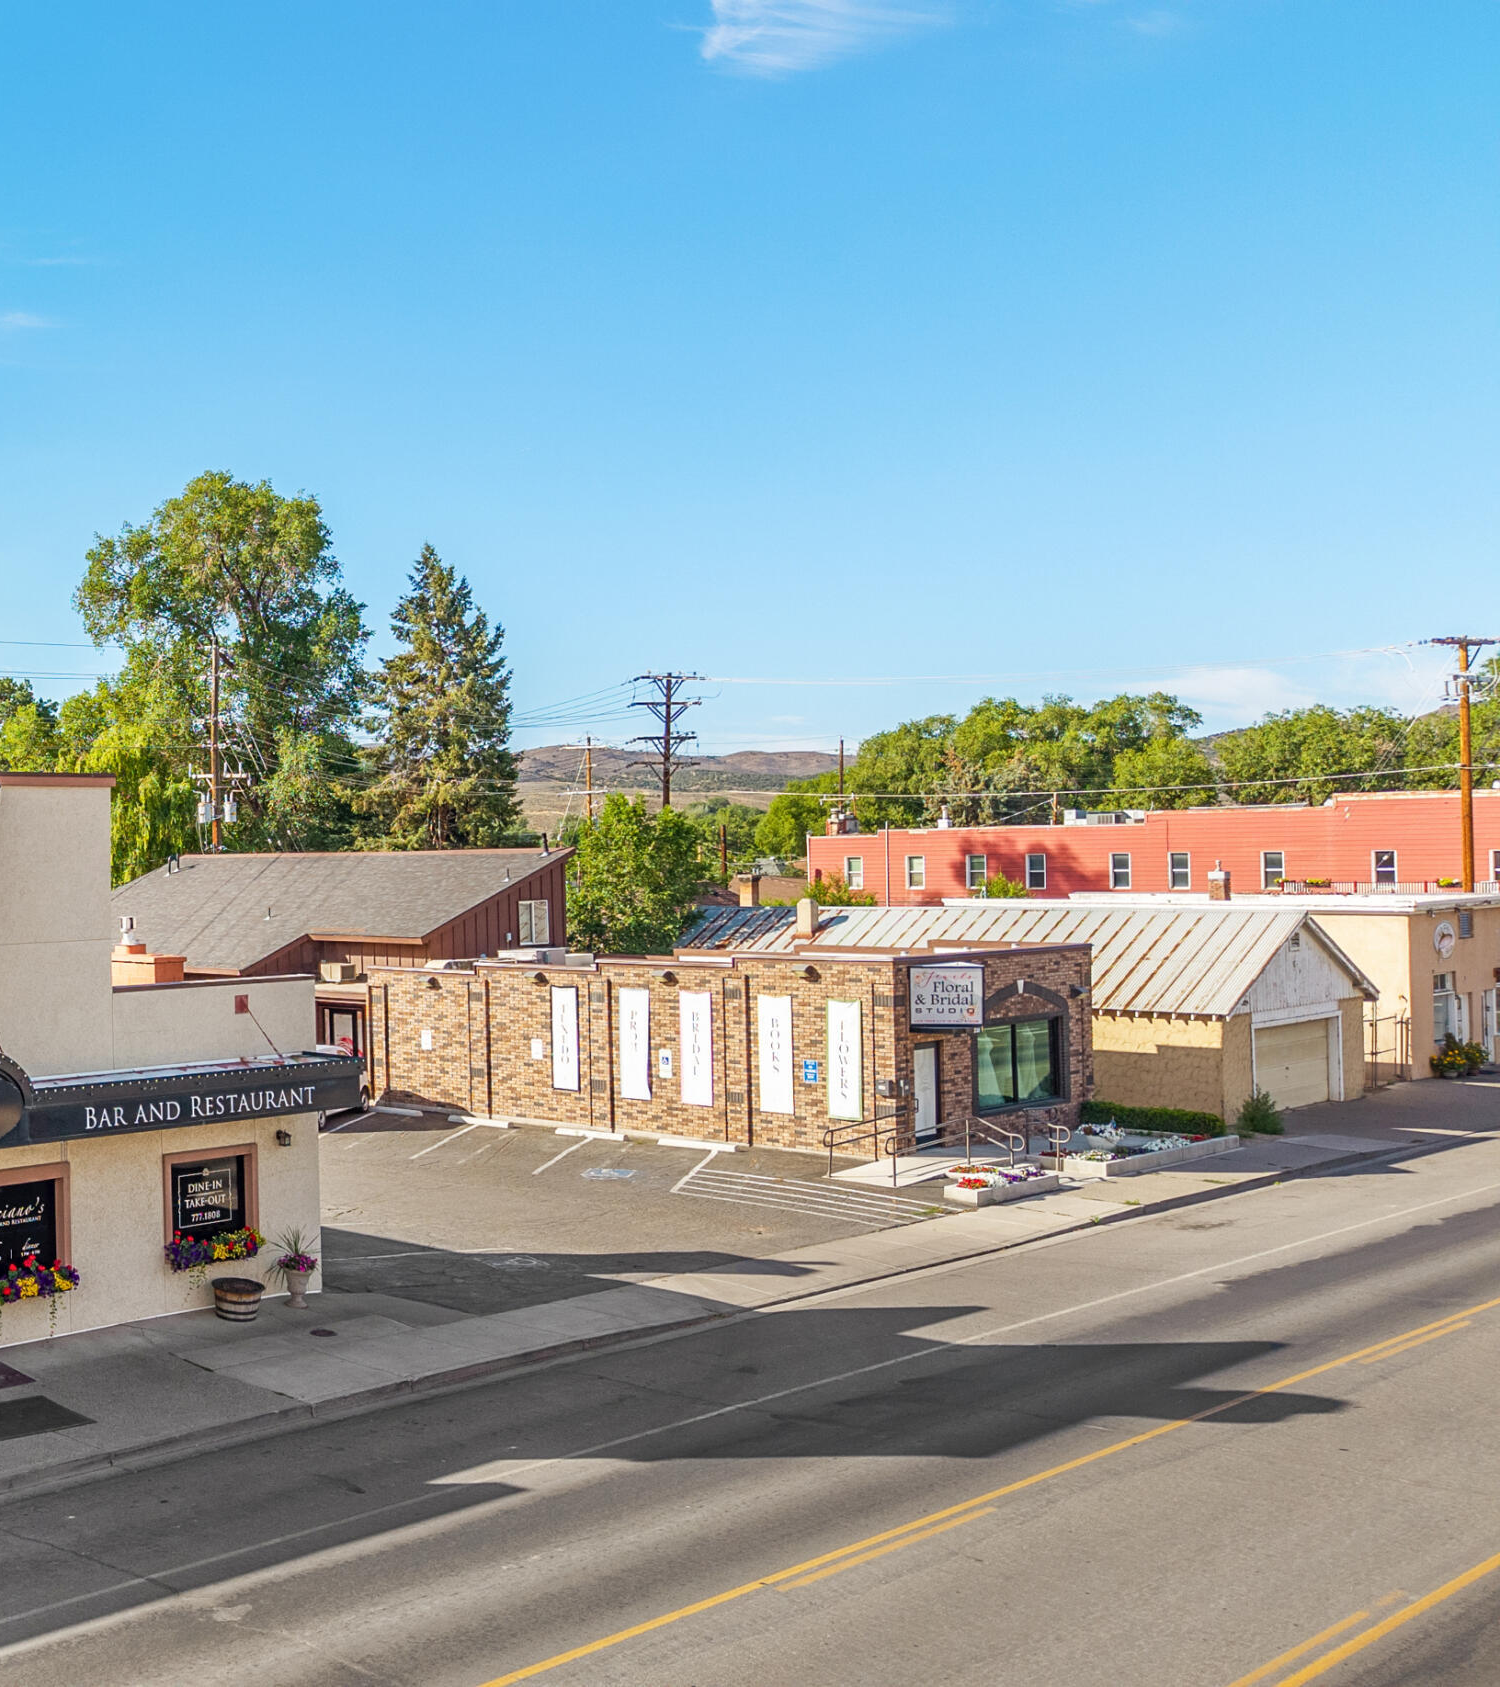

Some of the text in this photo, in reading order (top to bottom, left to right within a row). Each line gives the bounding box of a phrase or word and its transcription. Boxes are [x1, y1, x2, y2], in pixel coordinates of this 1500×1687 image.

[933, 980, 974, 993] Floral
[914, 993, 974, 1006] & Bridal
[914, 1007, 975, 1015] STUDIO
[691, 1011, 701, 1076] BRIDAL
[770, 1017, 781, 1073] BOOKS
[84, 1086, 317, 1131] BAR AND RESTAURANT
[187, 1179, 224, 1194] DINE-IN
[184, 1193, 227, 1209] TAKE-OUT
[0, 1220, 11, 1228] AND
[11, 1215, 43, 1225] RESTAURANT
[190, 1209, 222, 1223] 777.1808
